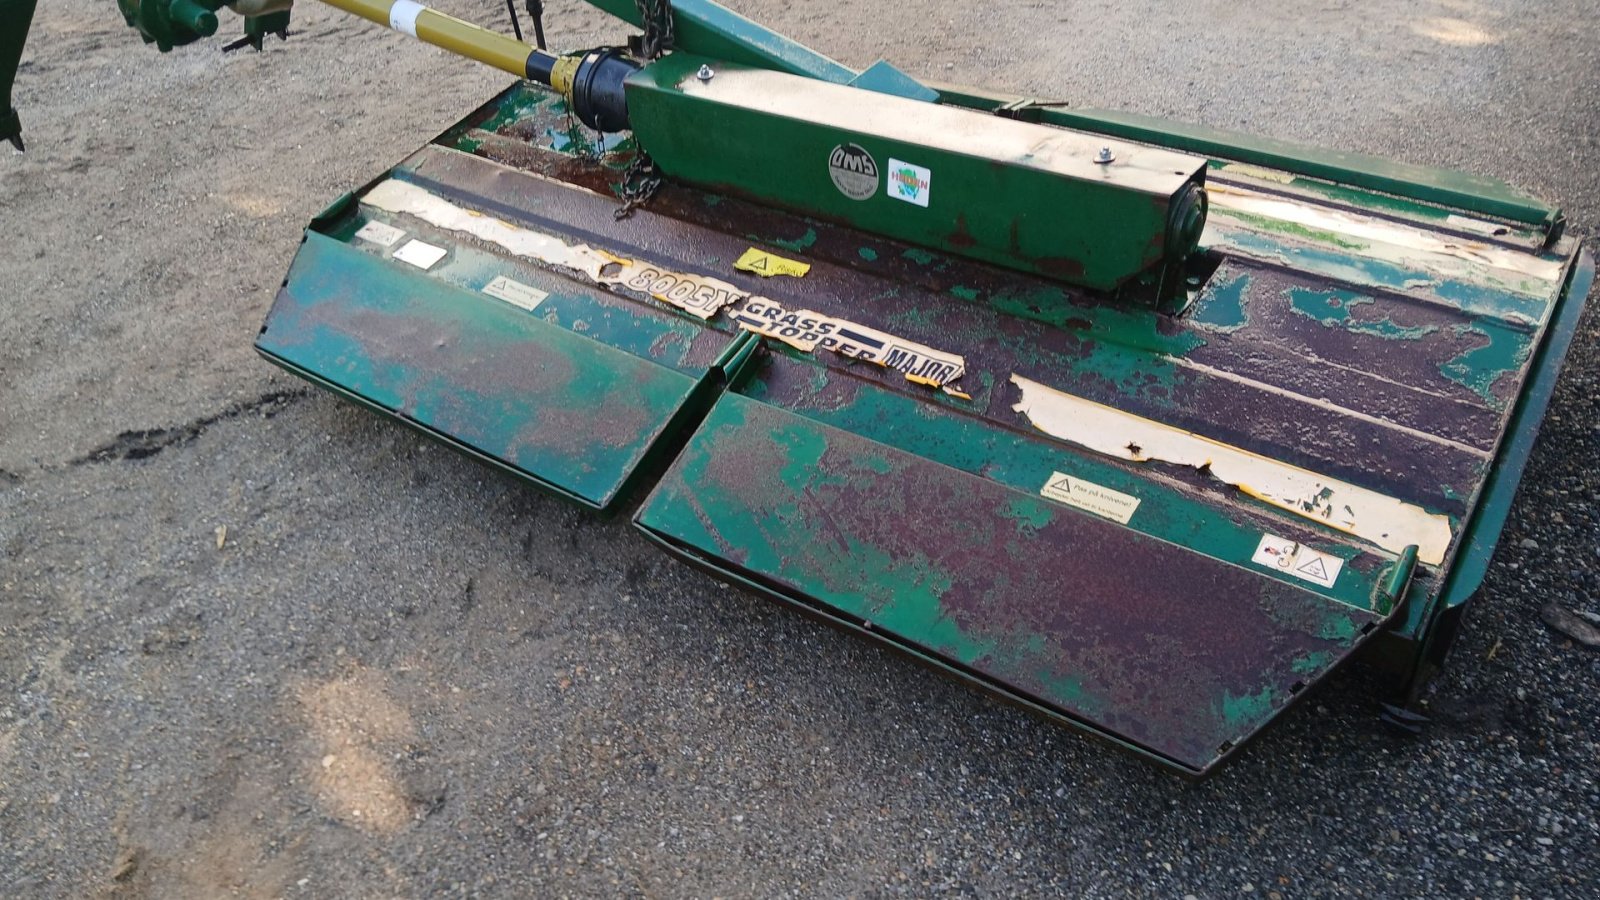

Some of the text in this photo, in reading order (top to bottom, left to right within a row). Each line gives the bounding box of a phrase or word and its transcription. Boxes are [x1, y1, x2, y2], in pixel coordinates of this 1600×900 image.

[745, 302, 836, 335] GRASS
[767, 322, 877, 360] TOPPER
[884, 349, 955, 384] MAJOR
